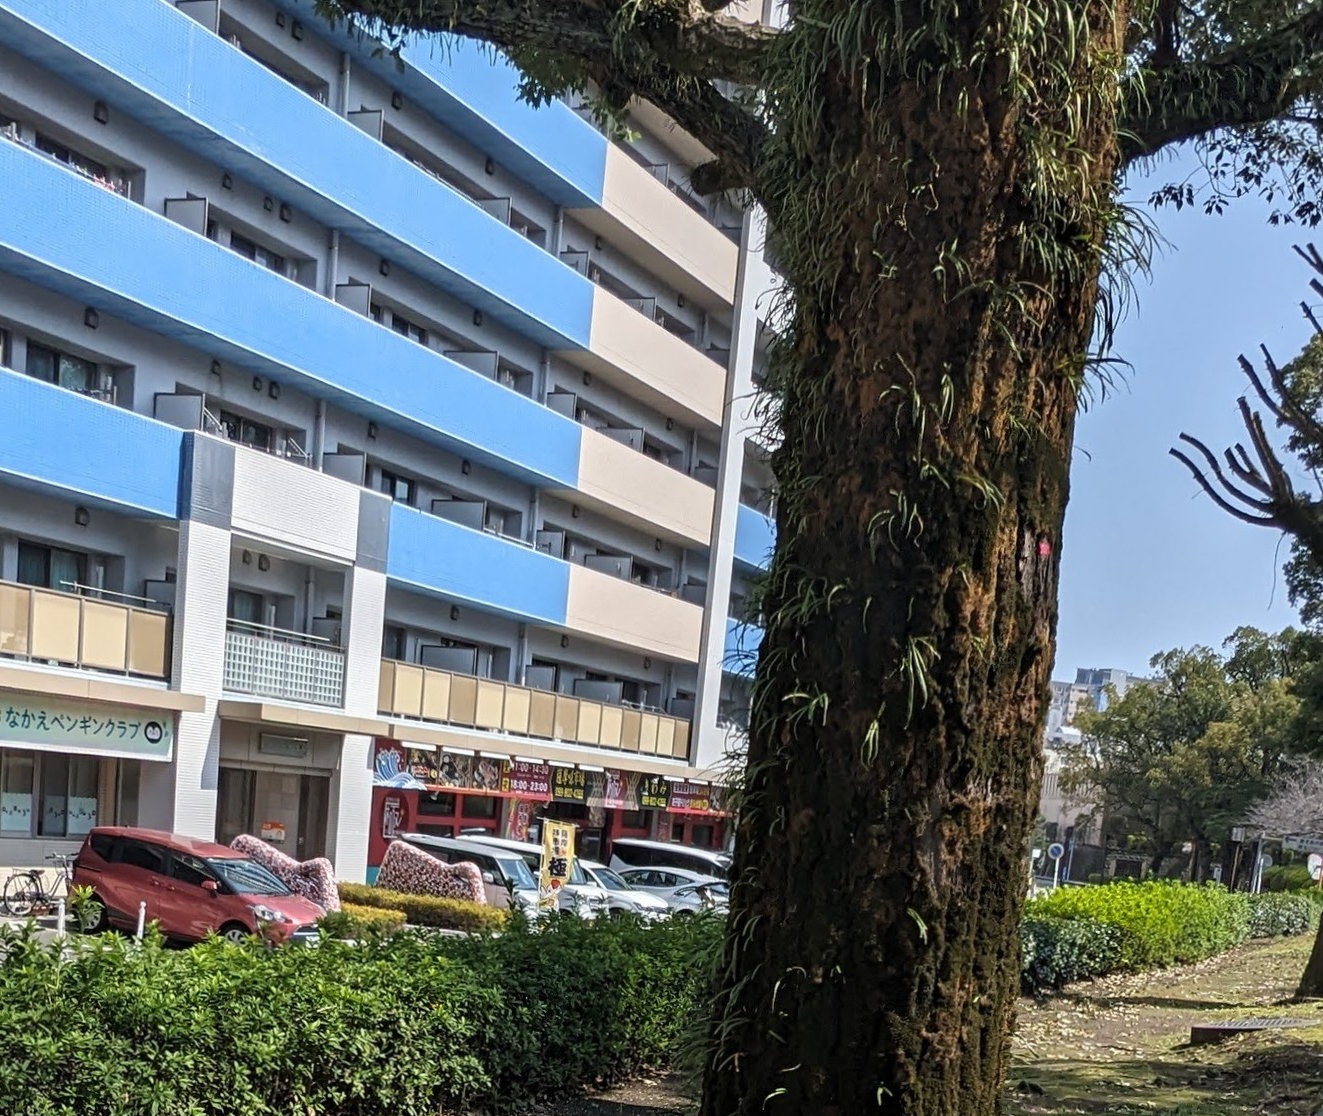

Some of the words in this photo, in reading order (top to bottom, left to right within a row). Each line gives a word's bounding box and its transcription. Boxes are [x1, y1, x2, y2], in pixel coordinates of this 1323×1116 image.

[5, 706, 141, 740] なかえペンギンクラブ
